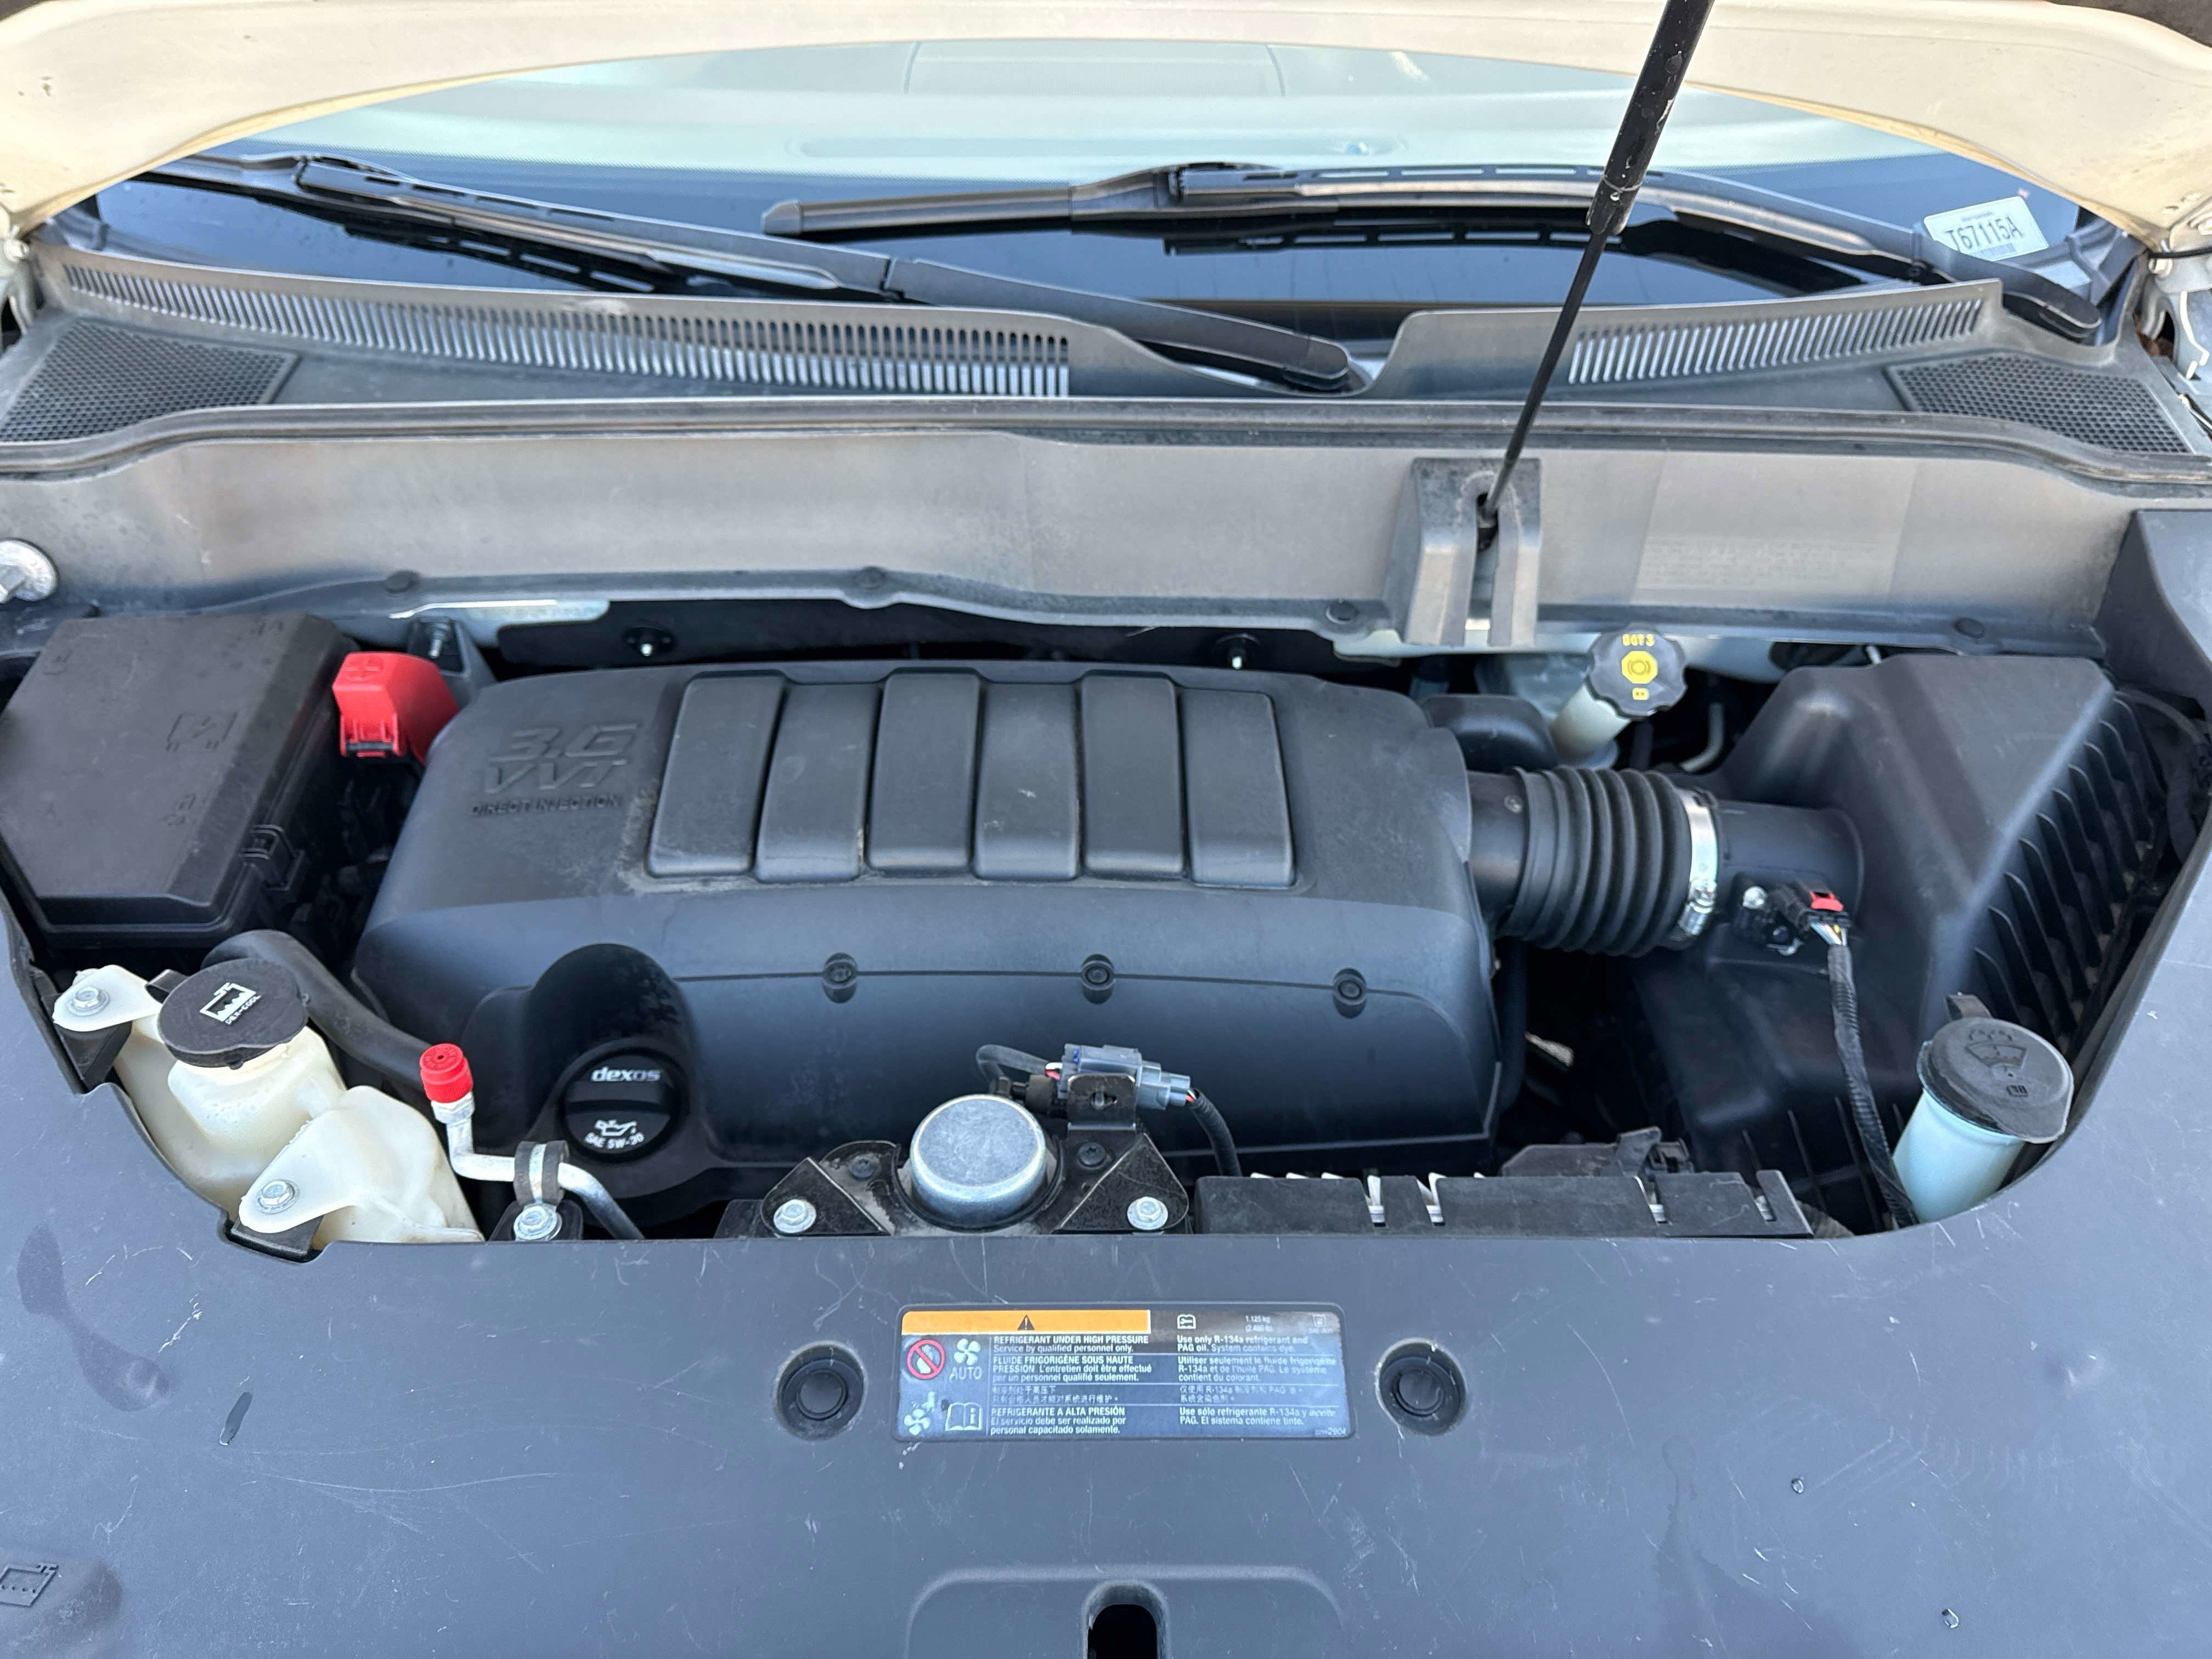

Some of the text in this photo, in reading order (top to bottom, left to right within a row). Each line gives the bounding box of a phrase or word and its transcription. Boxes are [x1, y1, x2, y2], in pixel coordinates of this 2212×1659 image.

[1944, 215, 2024, 253] T67115A
[1622, 633, 1655, 647] DOT 3
[488, 724, 641, 763] 3.6
[484, 759, 629, 794] VVT
[472, 795, 622, 816] DIRECT INJECTION
[591, 1066, 662, 1082] dexos
[584, 1132, 645, 1149] SAE 5W-30
[994, 1335, 1149, 1344] REFRIGERANT UNDER HIGH PRESSURE
[1177, 1335, 1308, 1345] Use only R-134a refrigerant and
[994, 1344, 1133, 1353] Service by qualified personnel only.
[1177, 1344, 1194, 1352] PAG
[1196, 1344, 1209, 1352] oil.
[1211, 1344, 1241, 1353] System
[1242, 1344, 1277, 1352] contains
[993, 1356, 1023, 1365] FLUIDE
[1081, 1356, 1104, 1364] SOUS
[1106, 1356, 1133, 1364] HAUTE
[1178, 1356, 1207, 1364] Utiliser
[1209, 1356, 1252, 1364] seulement
[949, 1366, 982, 1380] AUTO
[1039, 1364, 1081, 1373] L'entretien
[1083, 1364, 1099, 1373] doit
[1101, 1364, 1117, 1373] être
[1119, 1364, 1152, 1373] effectué
[1178, 1364, 1208, 1373] R-134a
[1220, 1365, 1230, 1373] de
[1279, 1365, 1289, 1374] Le
[1020, 1373, 1060, 1383] personnel
[1062, 1373, 1093, 1383] qualifié
[1094, 1373, 1139, 1382] seulement.
[991, 1405, 1125, 1416] REFRIGERANTE A ALTA PRESIÓN
[1180, 1407, 1195, 1415] Use
[1198, 1407, 1215, 1415] sólo
[1217, 1407, 1267, 1417] refrigerante
[1269, 1407, 1300, 1417] R-134a
[1302, 1409, 1307, 1418] y
[991, 1417, 999, 1425] El
[1001, 1417, 1033, 1425] servicio
[1035, 1417, 1056, 1425] debe
[1073, 1416, 1110, 1425] realizado
[1112, 1417, 1126, 1426] por
[1180, 1416, 1304, 1425] PAG. El sistema contiene tinte.
[990, 1425, 1120, 1436] personal capacitado solamente.
